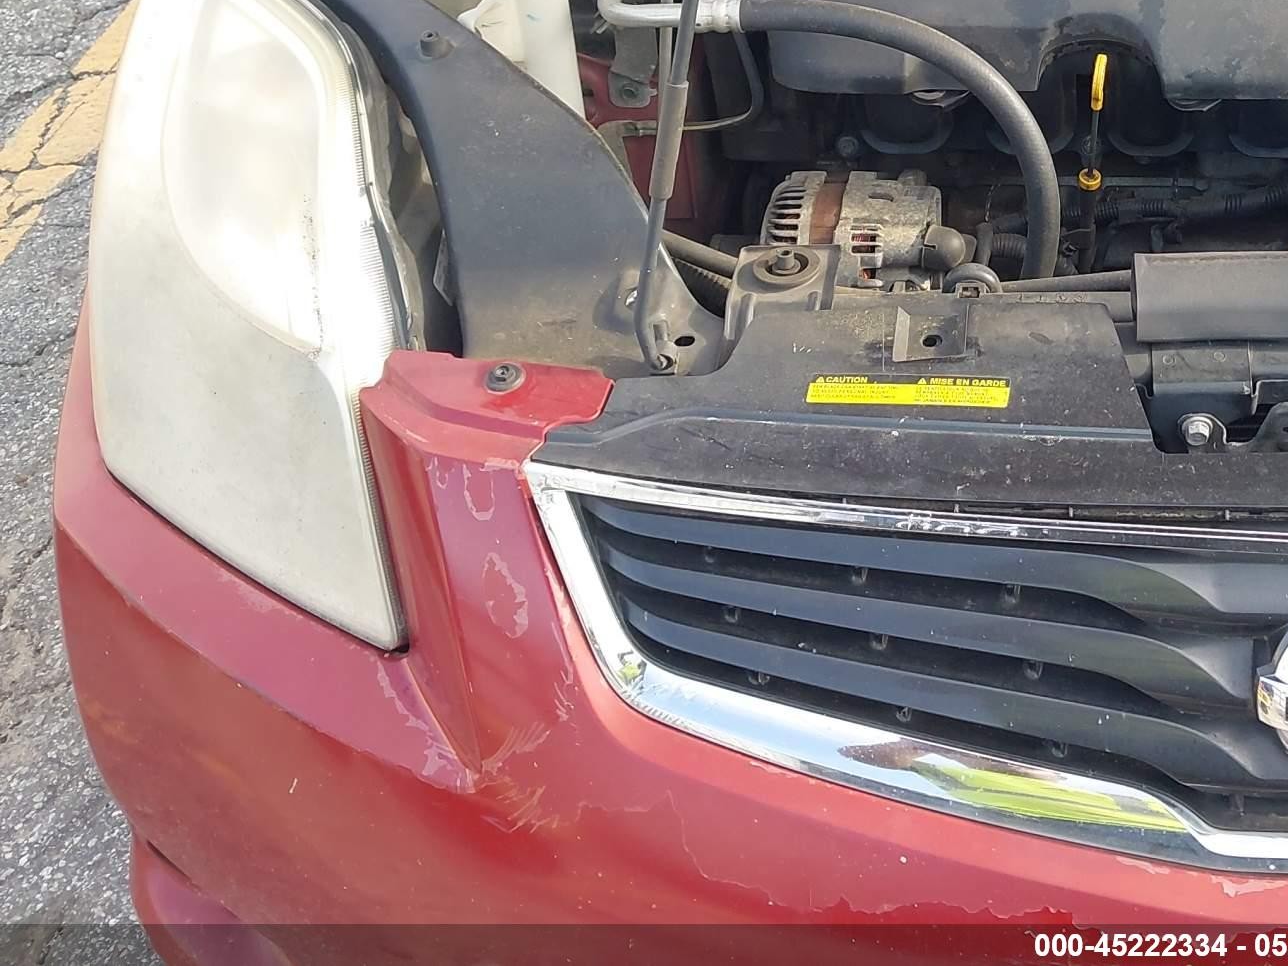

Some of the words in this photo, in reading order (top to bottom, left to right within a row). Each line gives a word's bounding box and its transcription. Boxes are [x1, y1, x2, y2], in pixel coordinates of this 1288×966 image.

[930, 377, 954, 385] MISE
[956, 378, 970, 386] EN
[972, 379, 1006, 387] GARDE
